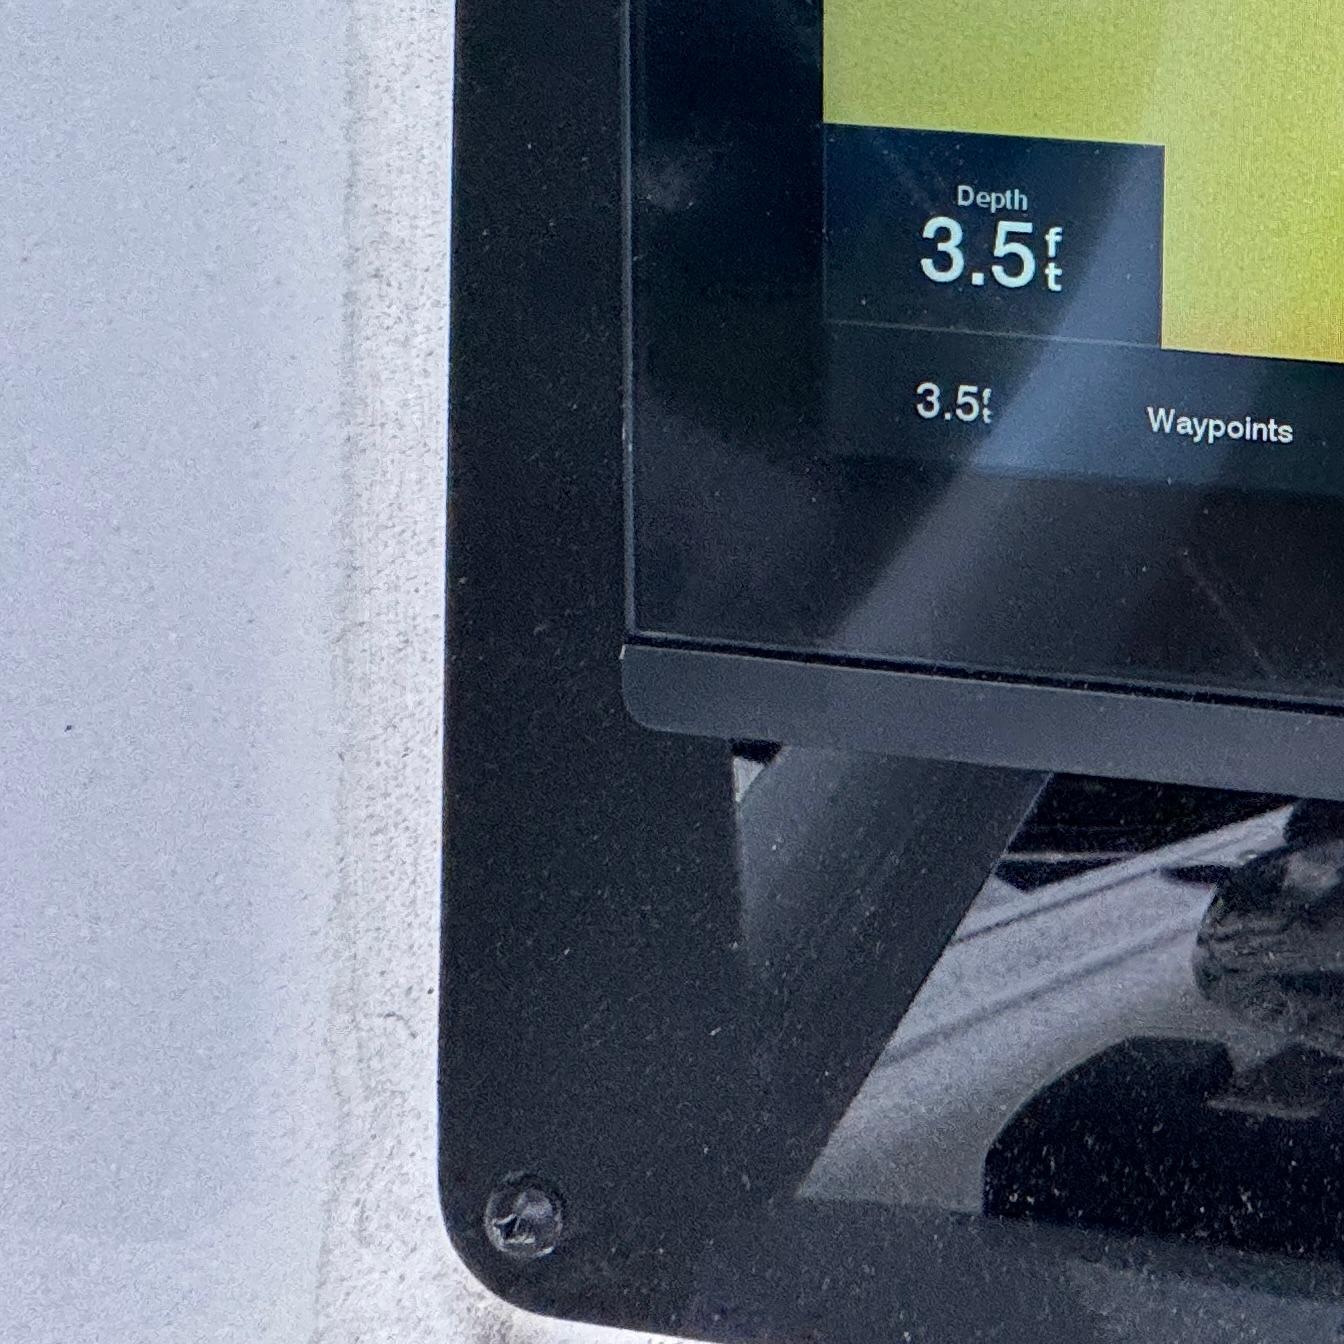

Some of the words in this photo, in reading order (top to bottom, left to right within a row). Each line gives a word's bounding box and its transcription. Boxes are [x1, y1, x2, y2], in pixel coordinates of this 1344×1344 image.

[957, 184, 1028, 213] Depth
[920, 216, 1036, 288] 3.5
[915, 381, 980, 423] 3.5
[1146, 406, 1294, 446] Waypoints
